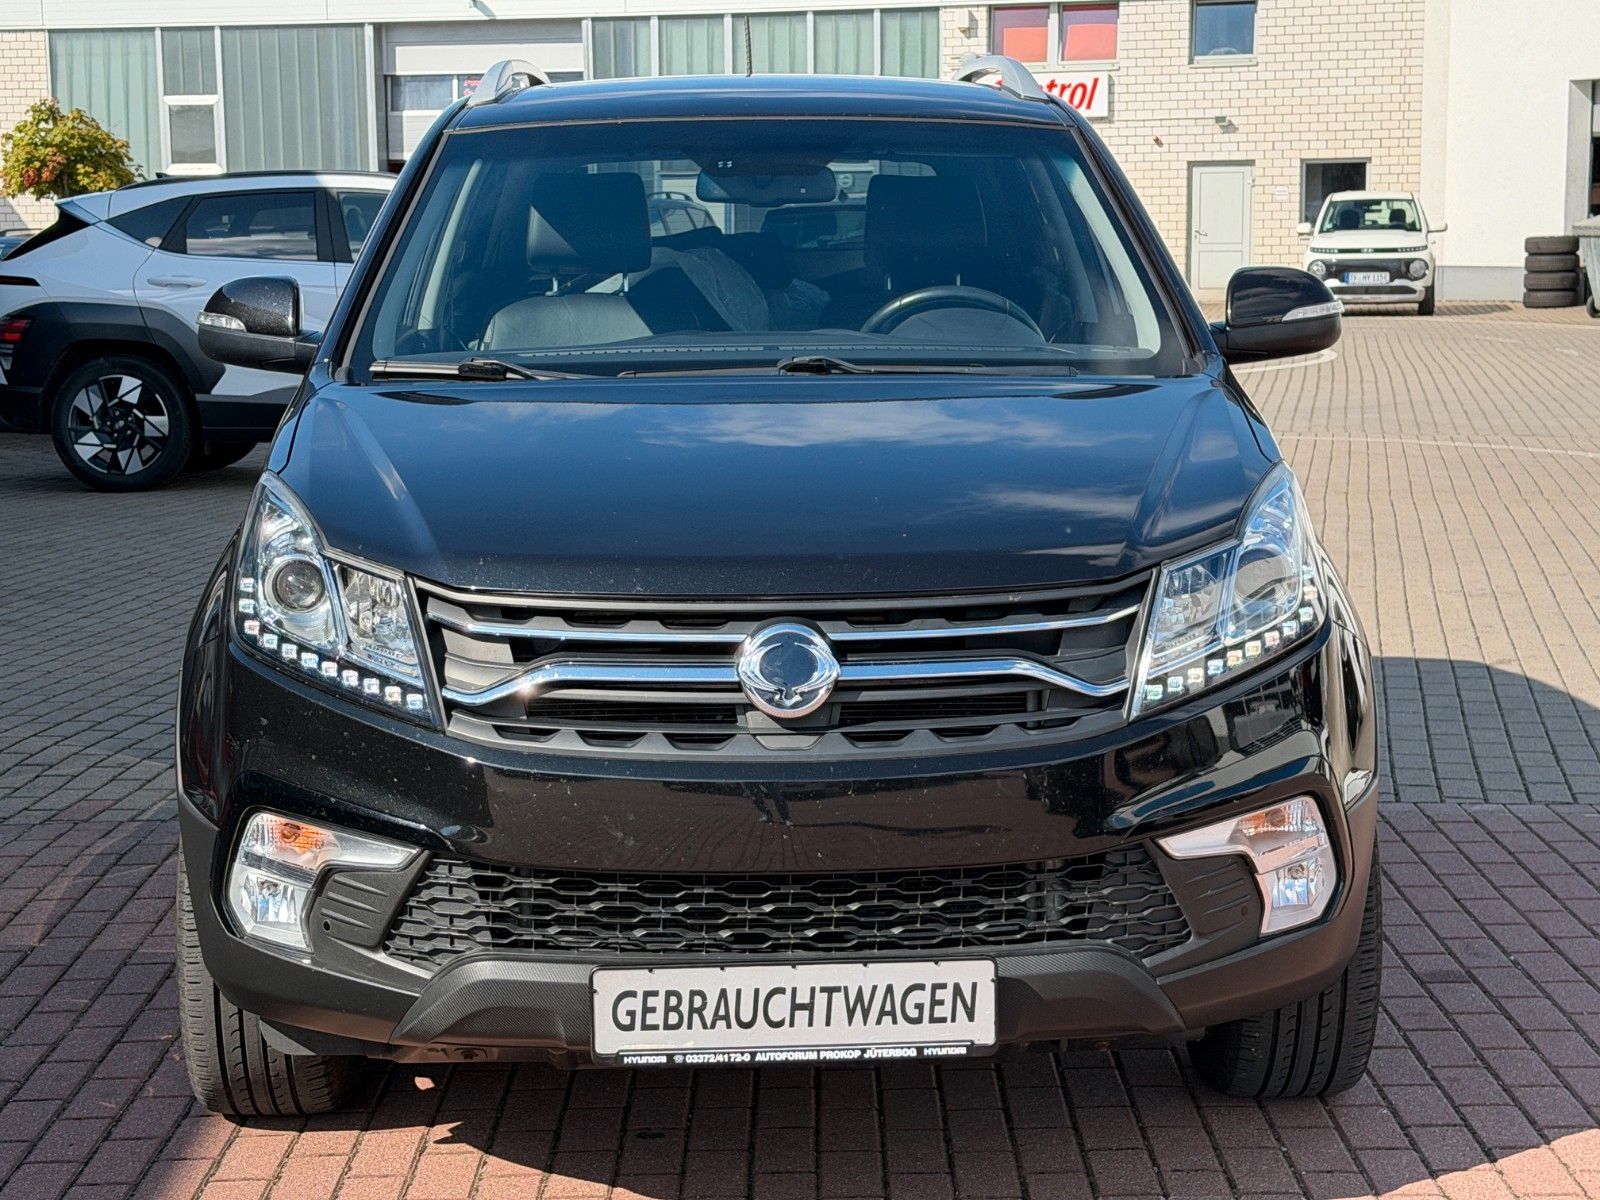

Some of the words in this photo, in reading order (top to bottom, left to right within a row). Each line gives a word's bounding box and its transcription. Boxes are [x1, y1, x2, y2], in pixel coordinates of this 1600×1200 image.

[1038, 77, 1100, 110] trol
[611, 981, 978, 1032] GEBRAUCHTWAGEN
[623, 1055, 667, 1064] HYUNDAI
[755, 1050, 818, 1062] AUTOFORUM
[819, 1049, 861, 1060] PROKOP
[863, 1047, 917, 1059] JÜTERBOG
[923, 1047, 967, 1056] HYUNDAI
